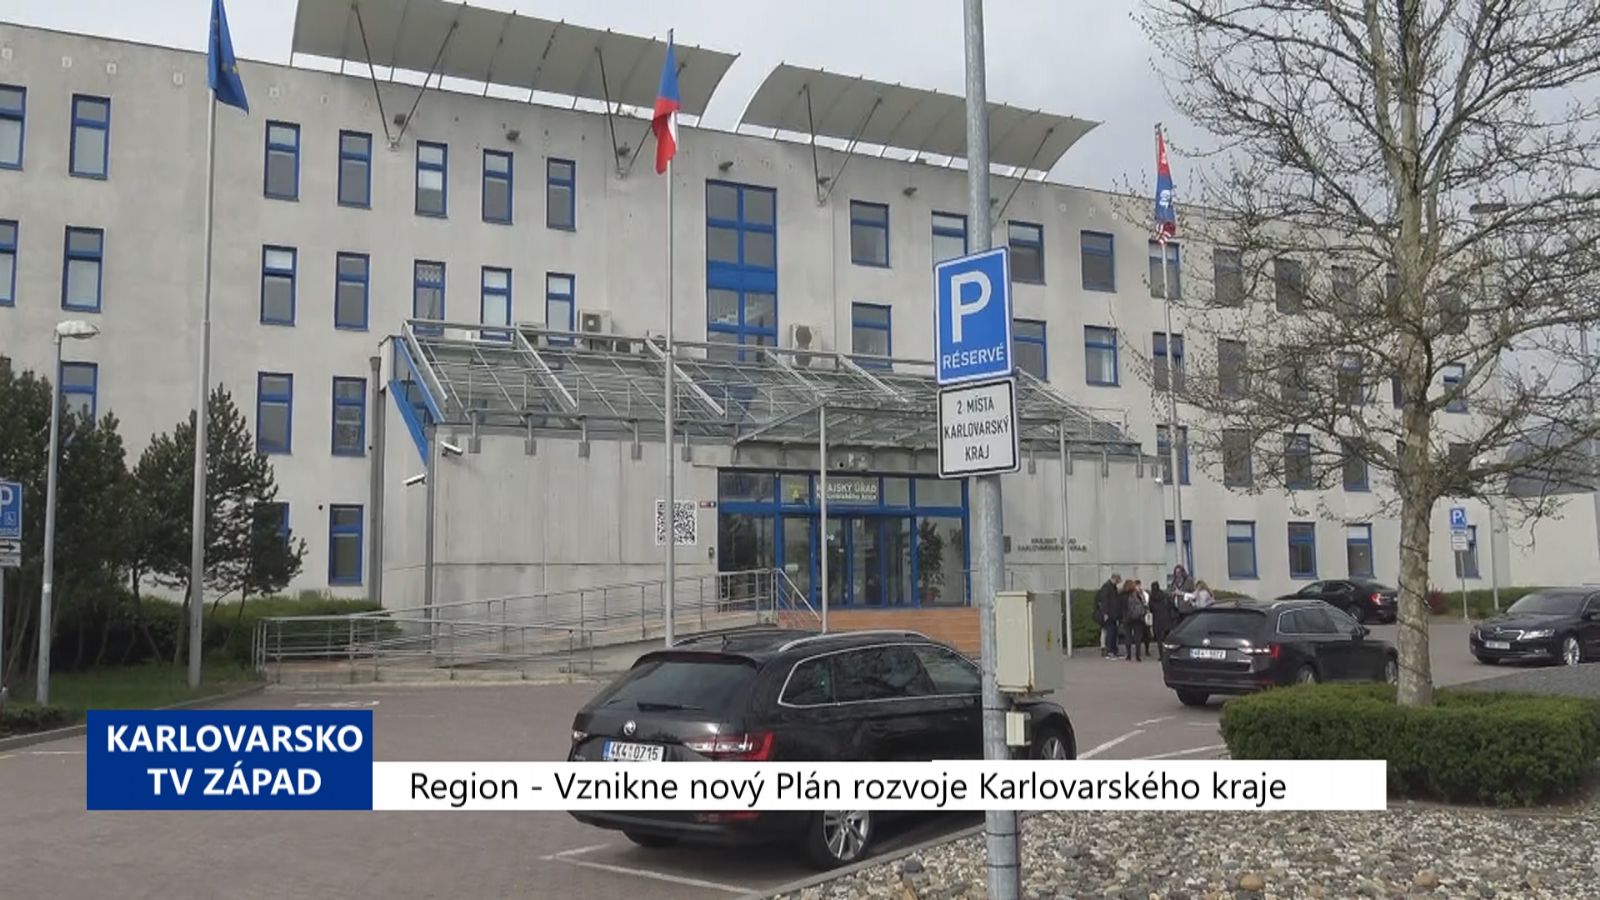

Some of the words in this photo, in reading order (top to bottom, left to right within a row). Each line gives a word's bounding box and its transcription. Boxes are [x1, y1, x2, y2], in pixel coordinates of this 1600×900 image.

[951, 270, 992, 343] P
[943, 343, 1004, 370] RÉSERVÉ
[956, 400, 963, 415] 2
[967, 395, 995, 413] MÍSTA
[944, 415, 1010, 439] KARLOVARSKÝ
[965, 444, 990, 461] KRAJ
[1452, 509, 1463, 524] P
